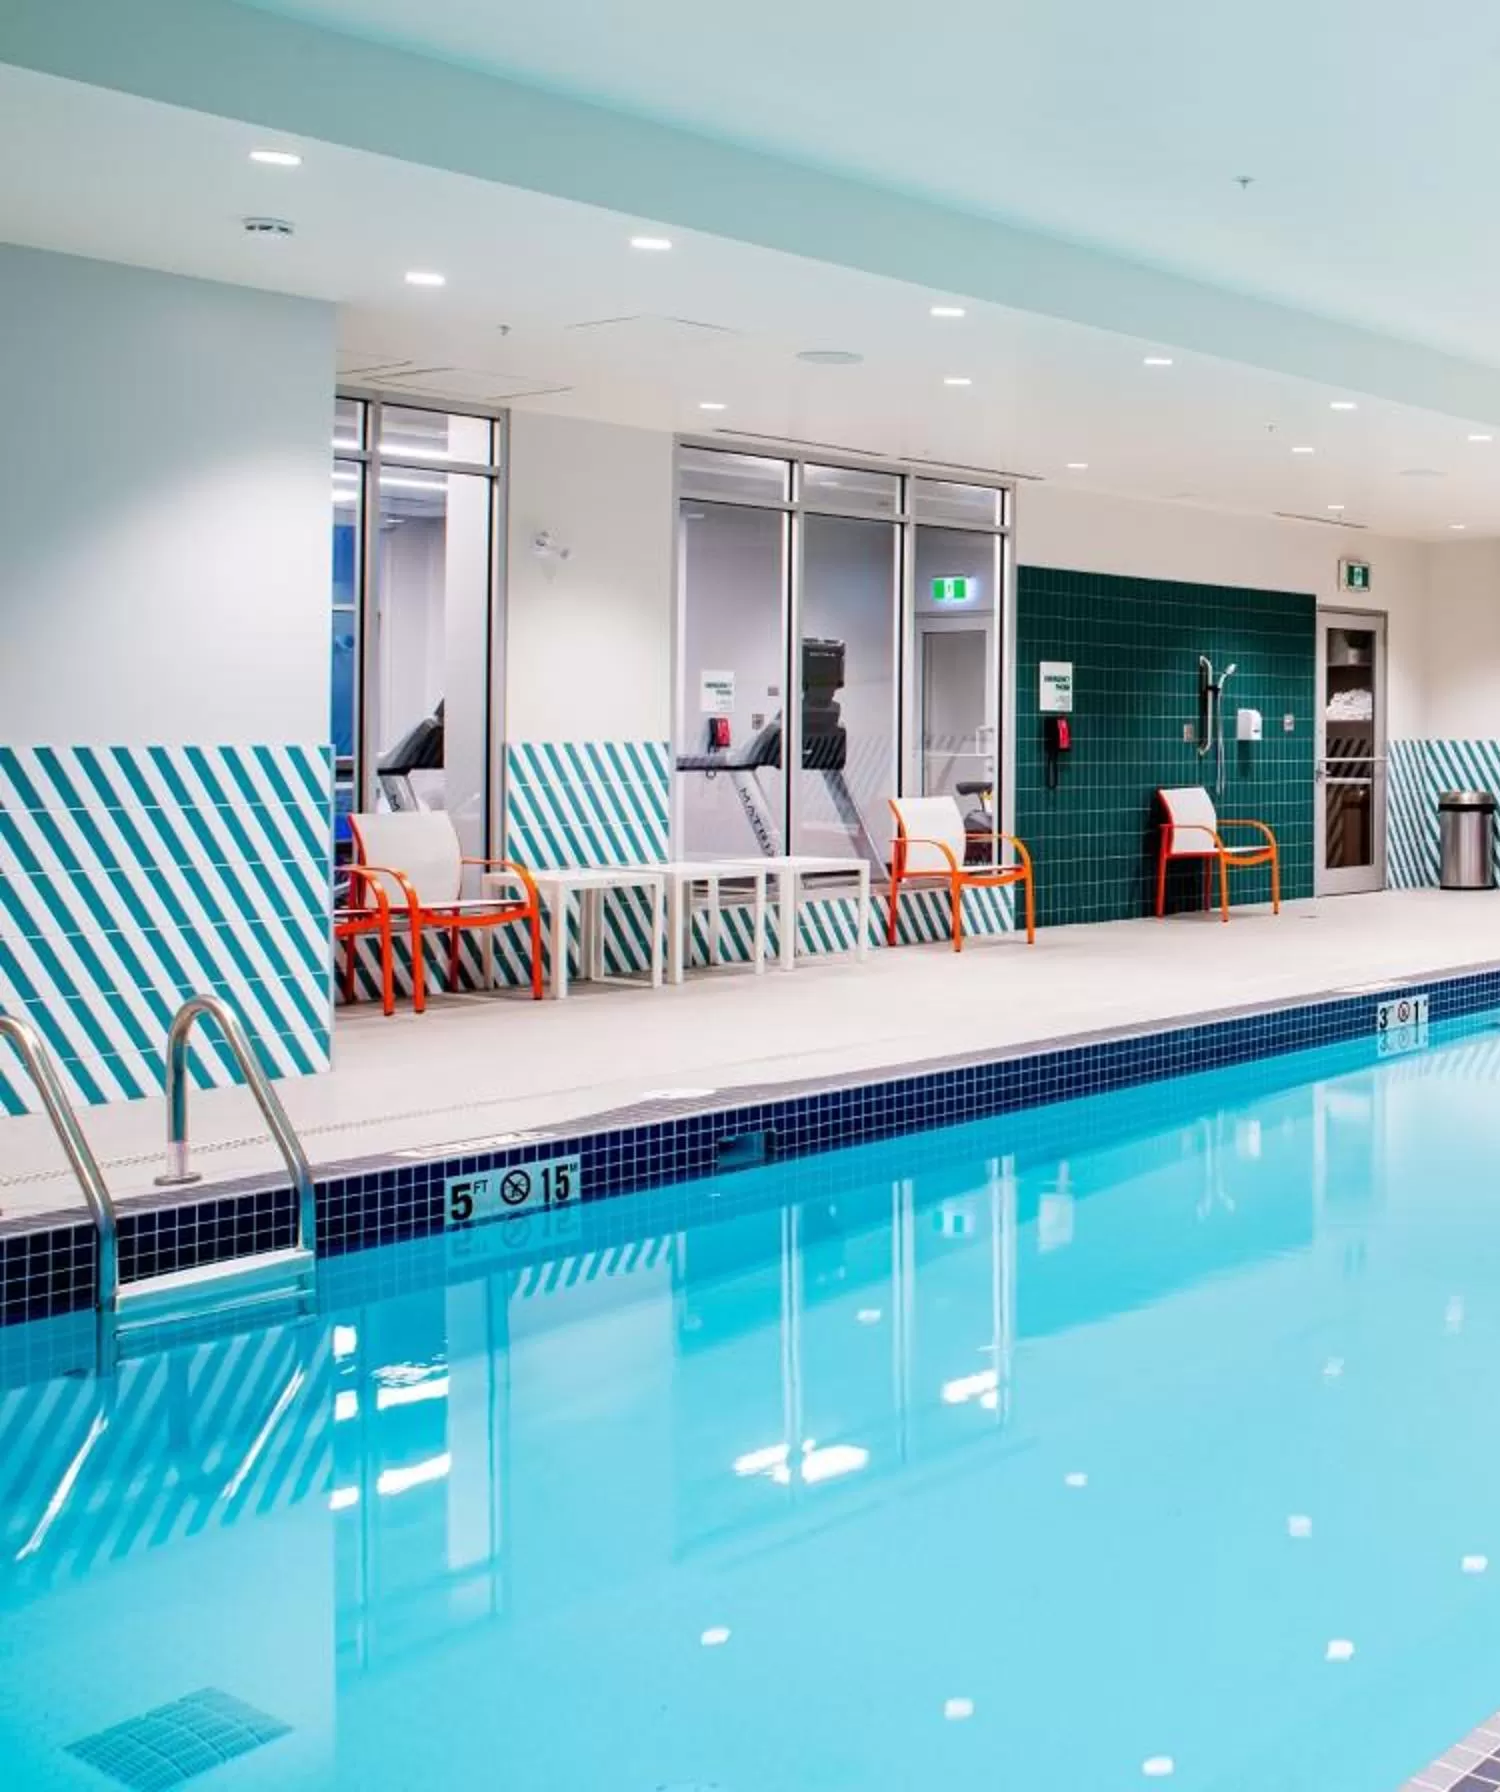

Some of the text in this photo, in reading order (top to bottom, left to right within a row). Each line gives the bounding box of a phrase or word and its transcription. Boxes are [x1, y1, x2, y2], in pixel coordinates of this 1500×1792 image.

[1380, 1007, 1388, 1029] 3
[451, 1183, 473, 1221] 5
[541, 1163, 569, 1204] 15
